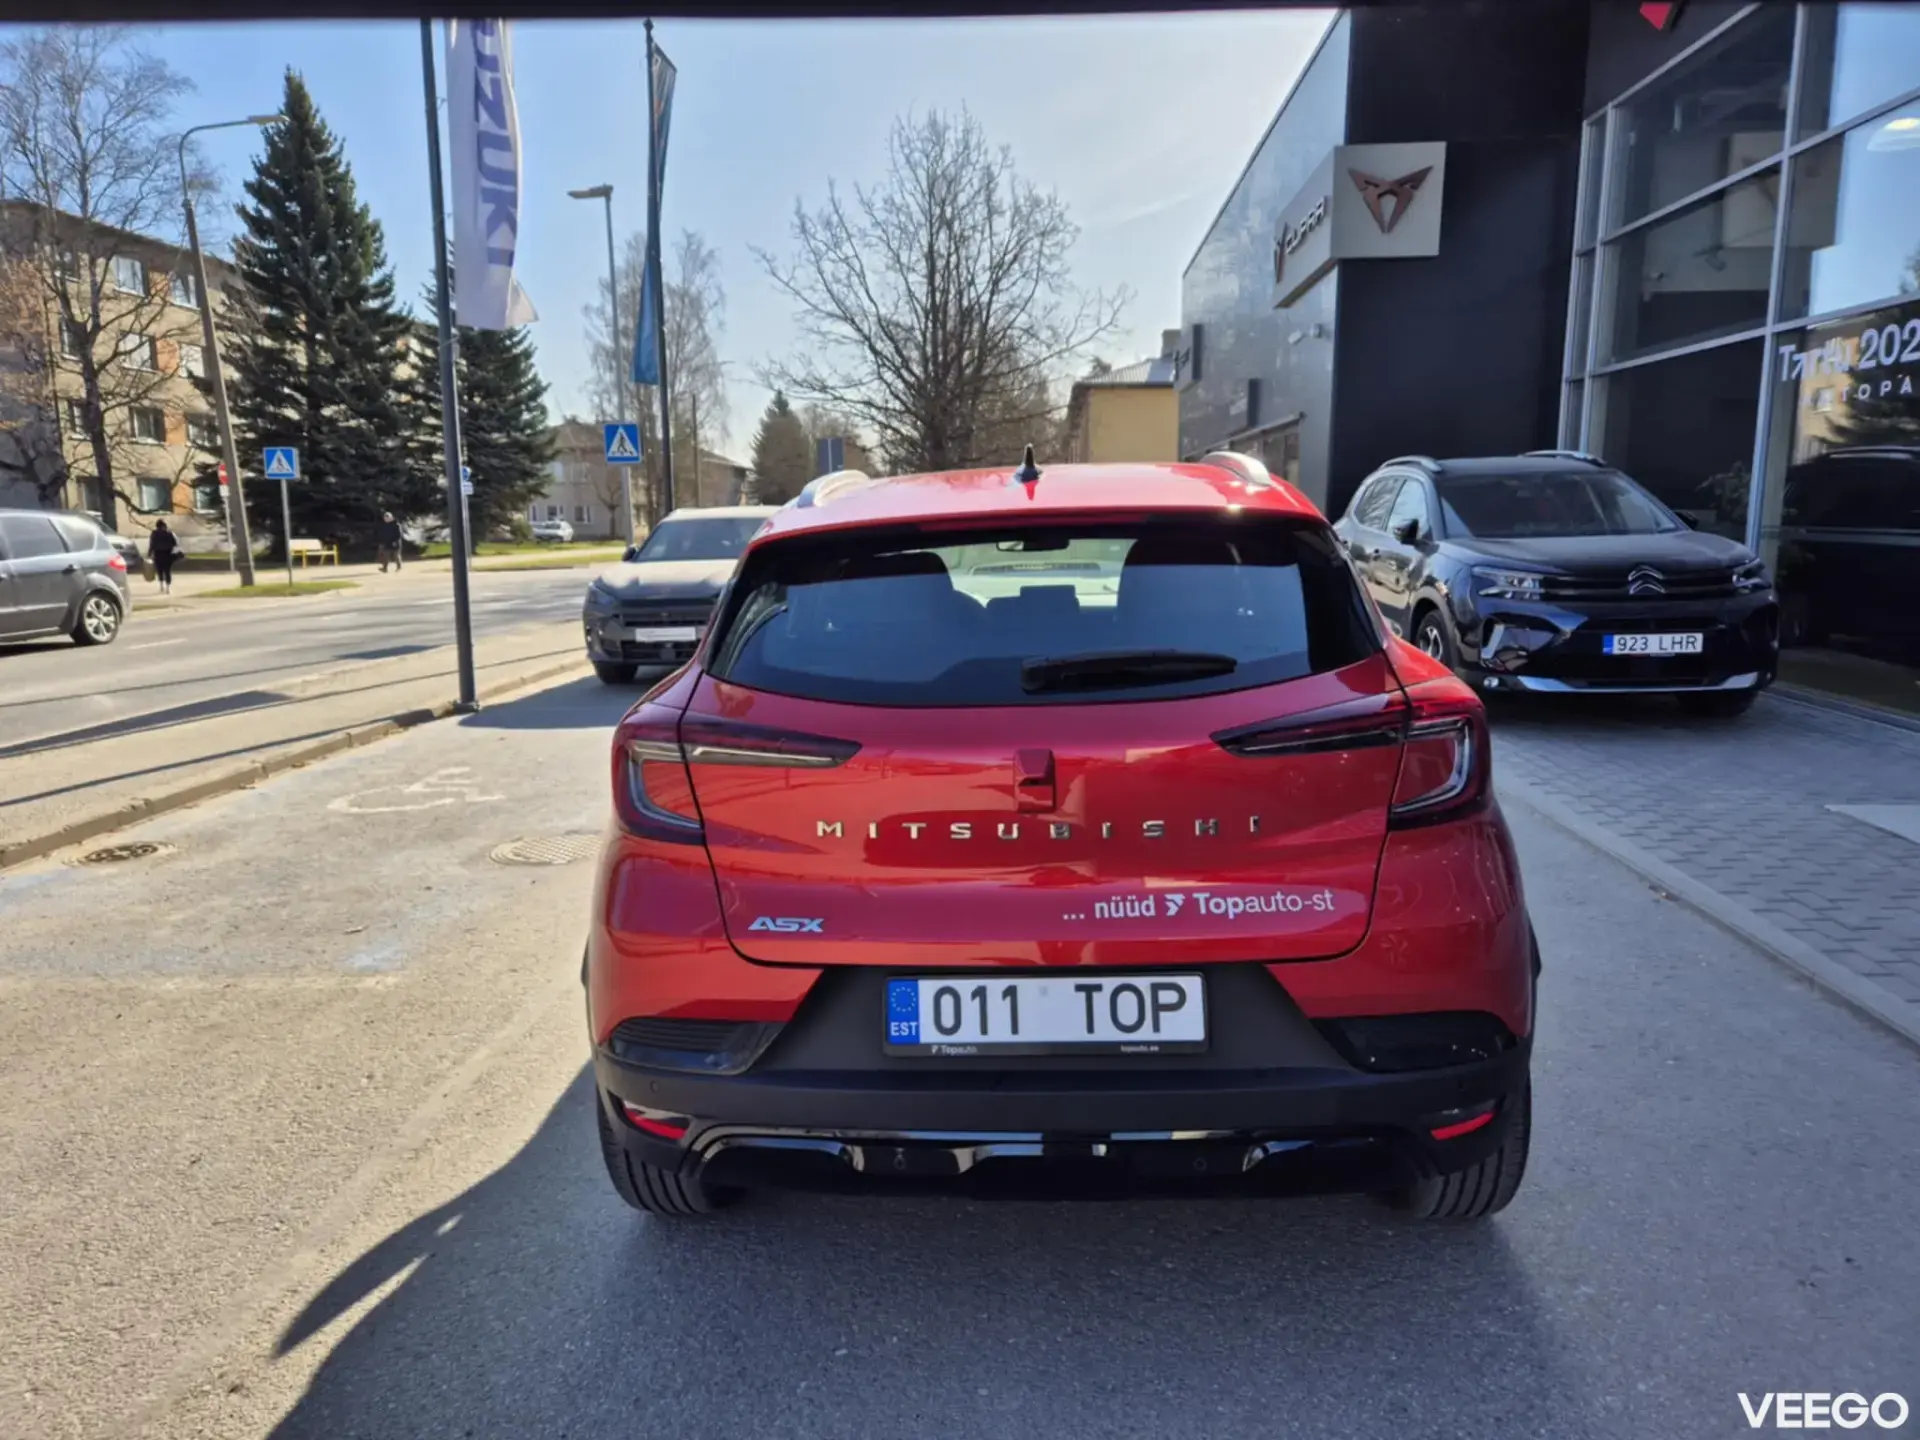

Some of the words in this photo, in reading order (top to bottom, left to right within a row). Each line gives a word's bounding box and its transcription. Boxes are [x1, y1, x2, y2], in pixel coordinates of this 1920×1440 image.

[1617, 636, 1649, 652] 923
[1659, 634, 1698, 651] LHR
[815, 817, 1260, 840] MITSUBISHI
[1094, 894, 1156, 919] nüüd
[1192, 889, 1335, 919] Topauto-st
[747, 915, 825, 933] ASX
[890, 1021, 919, 1037] EST
[932, 984, 1020, 1036] 011
[1073, 981, 1187, 1035] TOP
